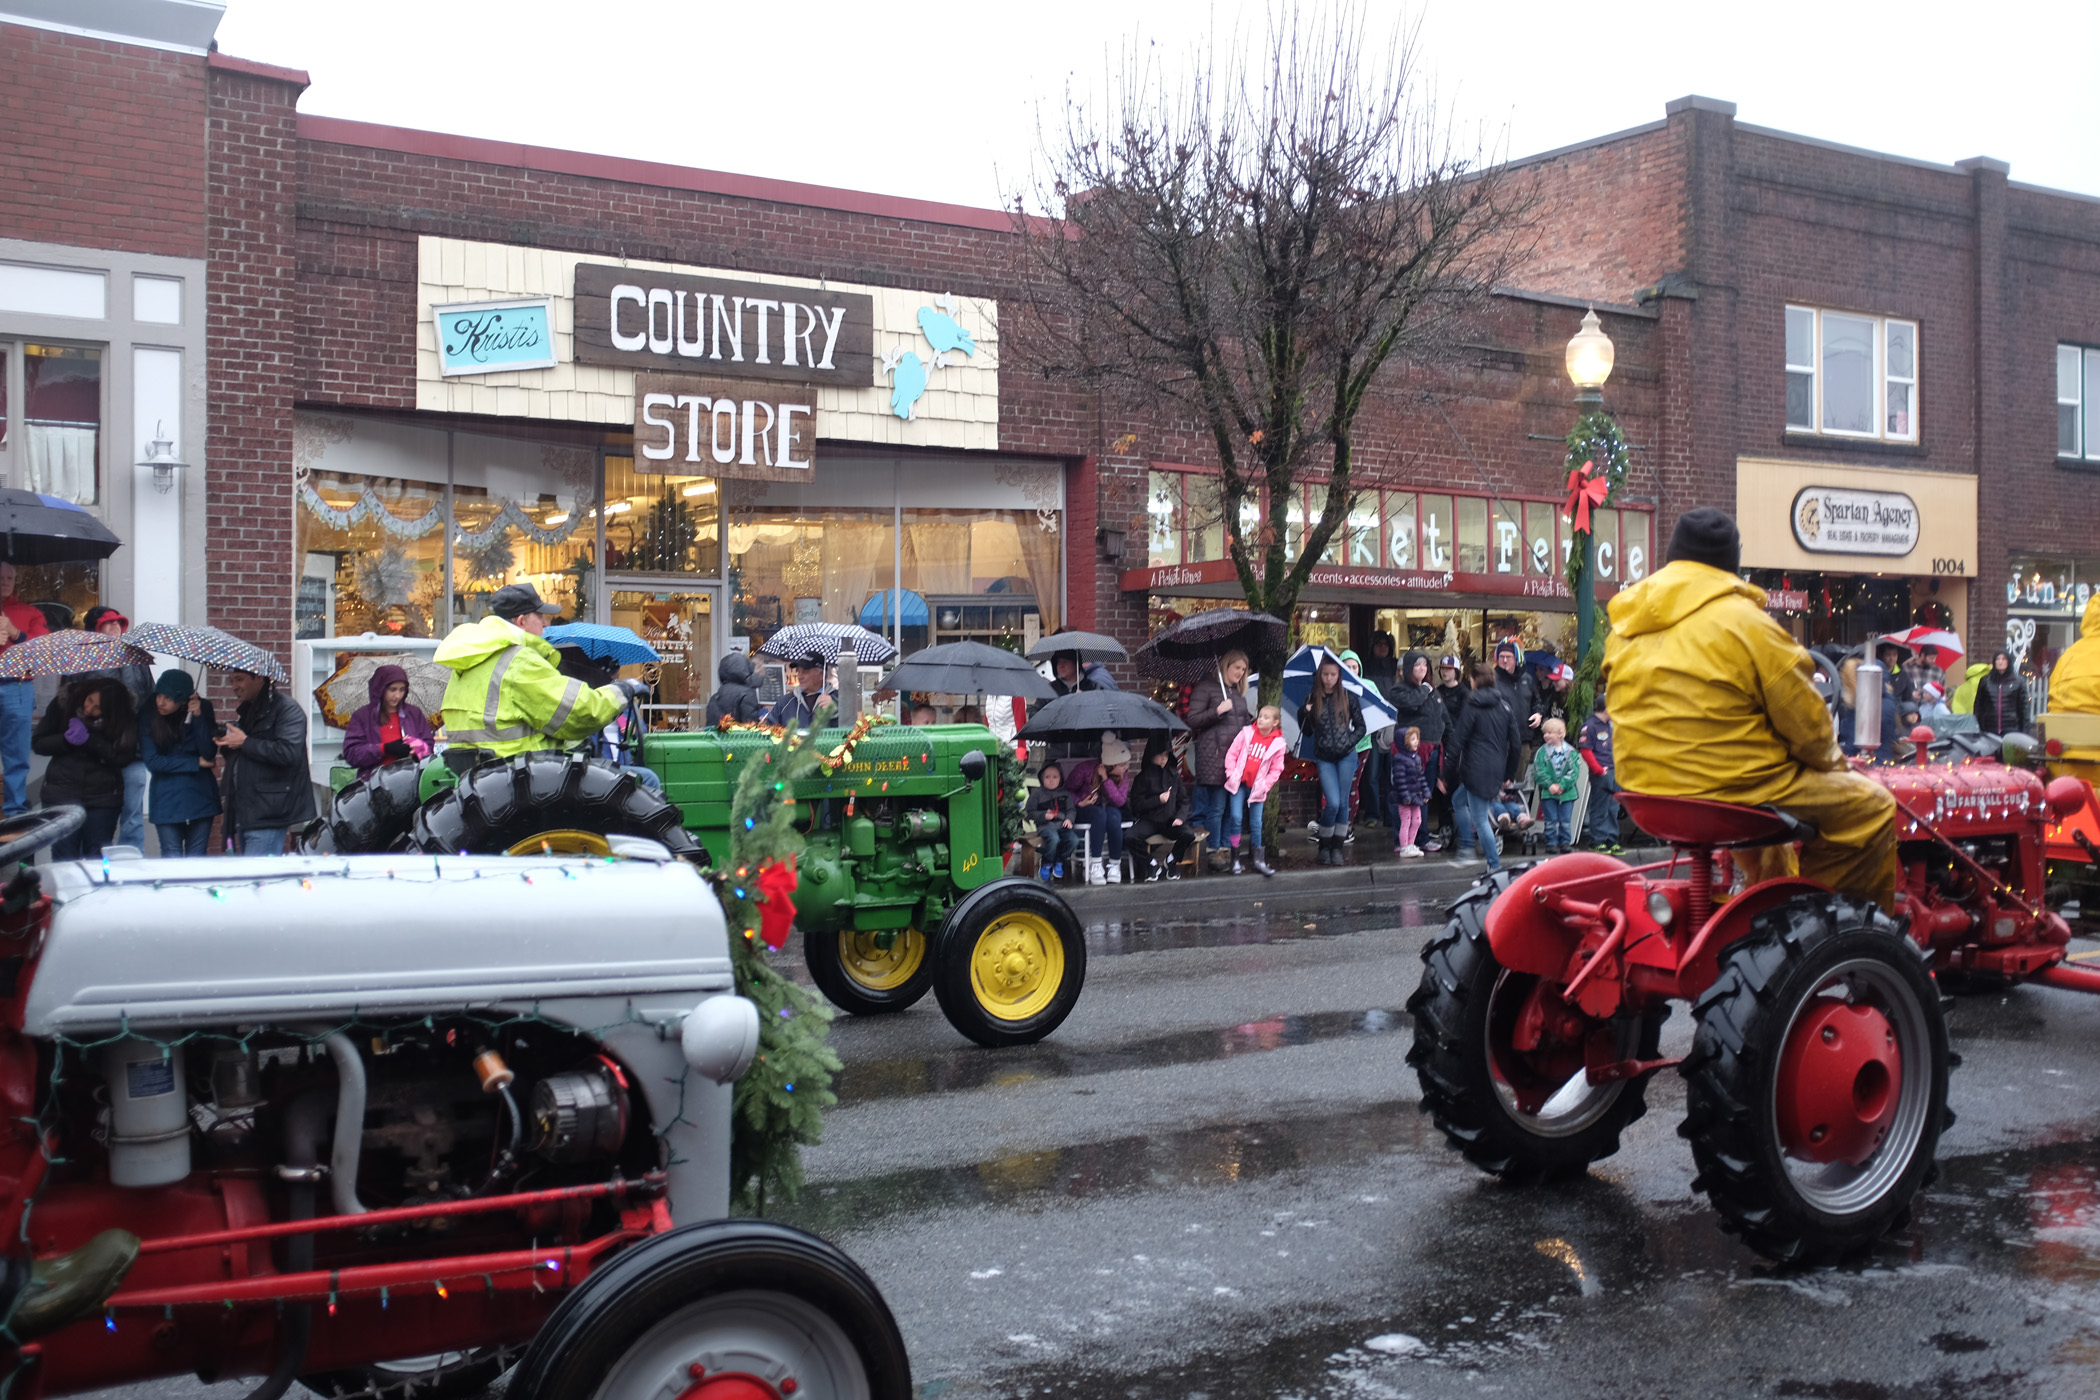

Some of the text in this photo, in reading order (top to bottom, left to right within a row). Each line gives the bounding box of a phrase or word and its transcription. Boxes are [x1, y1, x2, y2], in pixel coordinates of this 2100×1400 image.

[446, 312, 542, 363] Kristi's
[609, 284, 847, 370] COUNTRY
[642, 392, 811, 470] STORE
[1823, 497, 1913, 529] Spartan Agency
[1238, 501, 1443, 568] Pket
[1150, 565, 1202, 587] A Picket Fence
[1931, 557, 1965, 576] 1004
[1308, 572, 1343, 585] accents
[1349, 574, 1401, 587] accessories
[1523, 576, 1572, 598] A Picket Fen
[842, 760, 910, 773] JOHN DEERE
[962, 853, 978, 873] 40
